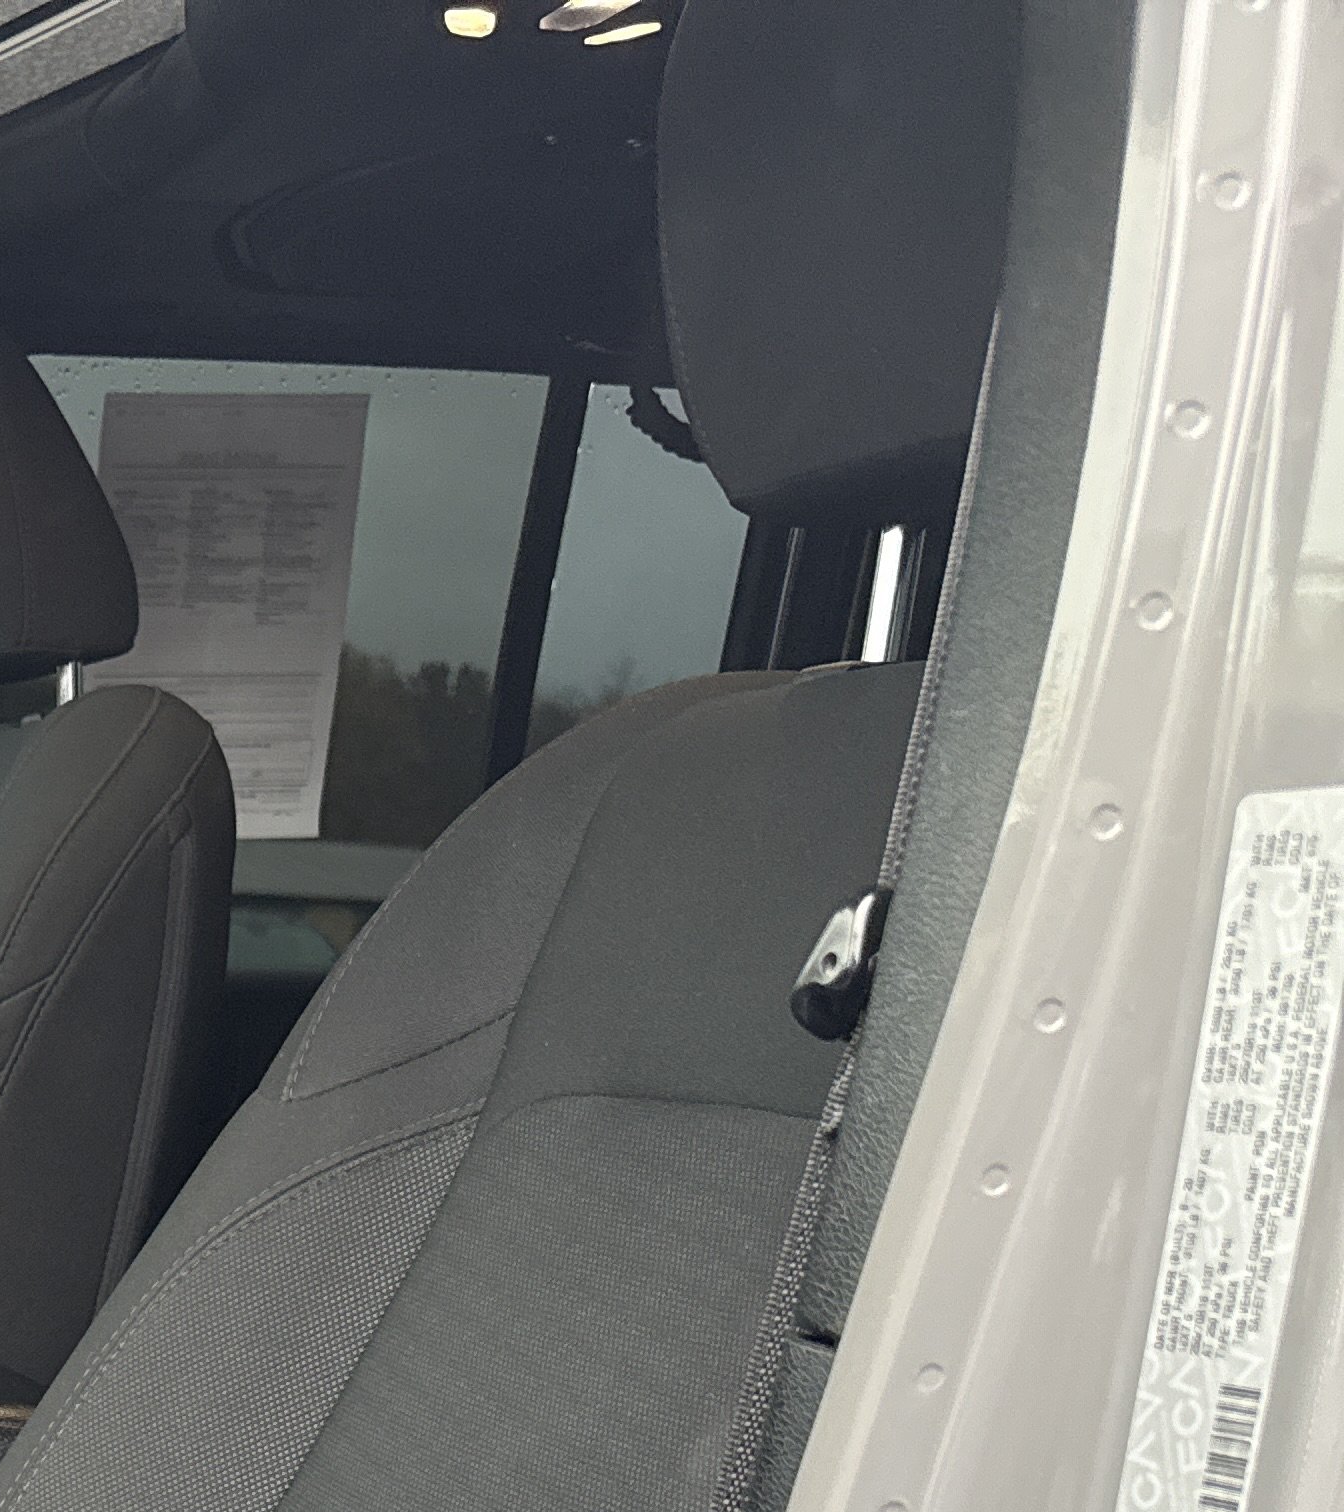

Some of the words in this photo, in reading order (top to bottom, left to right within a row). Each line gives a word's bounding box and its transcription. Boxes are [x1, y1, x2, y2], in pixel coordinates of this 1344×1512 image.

[1249, 834, 1265, 866] WITH
[1261, 834, 1277, 866] RIMS
[1273, 829, 1291, 865] TIRES
[1287, 832, 1304, 864] COLD
[1309, 859, 1330, 910] VEHICLE
[1327, 872, 1341, 888] OF
[1320, 894, 1338, 926] DATE
[1301, 915, 1320, 959] MOTOR
[1315, 931, 1331, 954] THE
[1311, 960, 1326, 977] ON
[1290, 963, 1312, 1021] FEDERAL
[1302, 983, 1322, 1028] EFFECT
[1299, 1033, 1313, 1045] IN
[1309, 1024, 1329, 1068] ABOVE
[1268, 1067, 1293, 1143] APPLICABLE
[1284, 1050, 1310, 1127] STANDARDS
[1299, 1073, 1320, 1120] SHOWN
[1204, 1099, 1219, 1132] WITH
[1227, 1098, 1244, 1135] TIRES
[1240, 1102, 1257, 1135] COLD
[1198, 1148, 1211, 1164] KG
[1264, 1147, 1278, 1169] ALL
[1270, 1130, 1295, 1208] PREVENTION
[1282, 1123, 1310, 1217] MANUFACTURE
[1260, 1173, 1274, 1188] TO
[1247, 1193, 1270, 1261] CONFORMS
[1262, 1214, 1279, 1251] THEFT
[1256, 1255, 1272, 1282] AND
[1159, 1298, 1172, 1315] OF
[1221, 1279, 1238, 1319] TRUCK
[1237, 1263, 1257, 1314] VEHICLE
[1247, 1286, 1266, 1332] SAFETY
[1153, 1318, 1168, 1349] DATE
